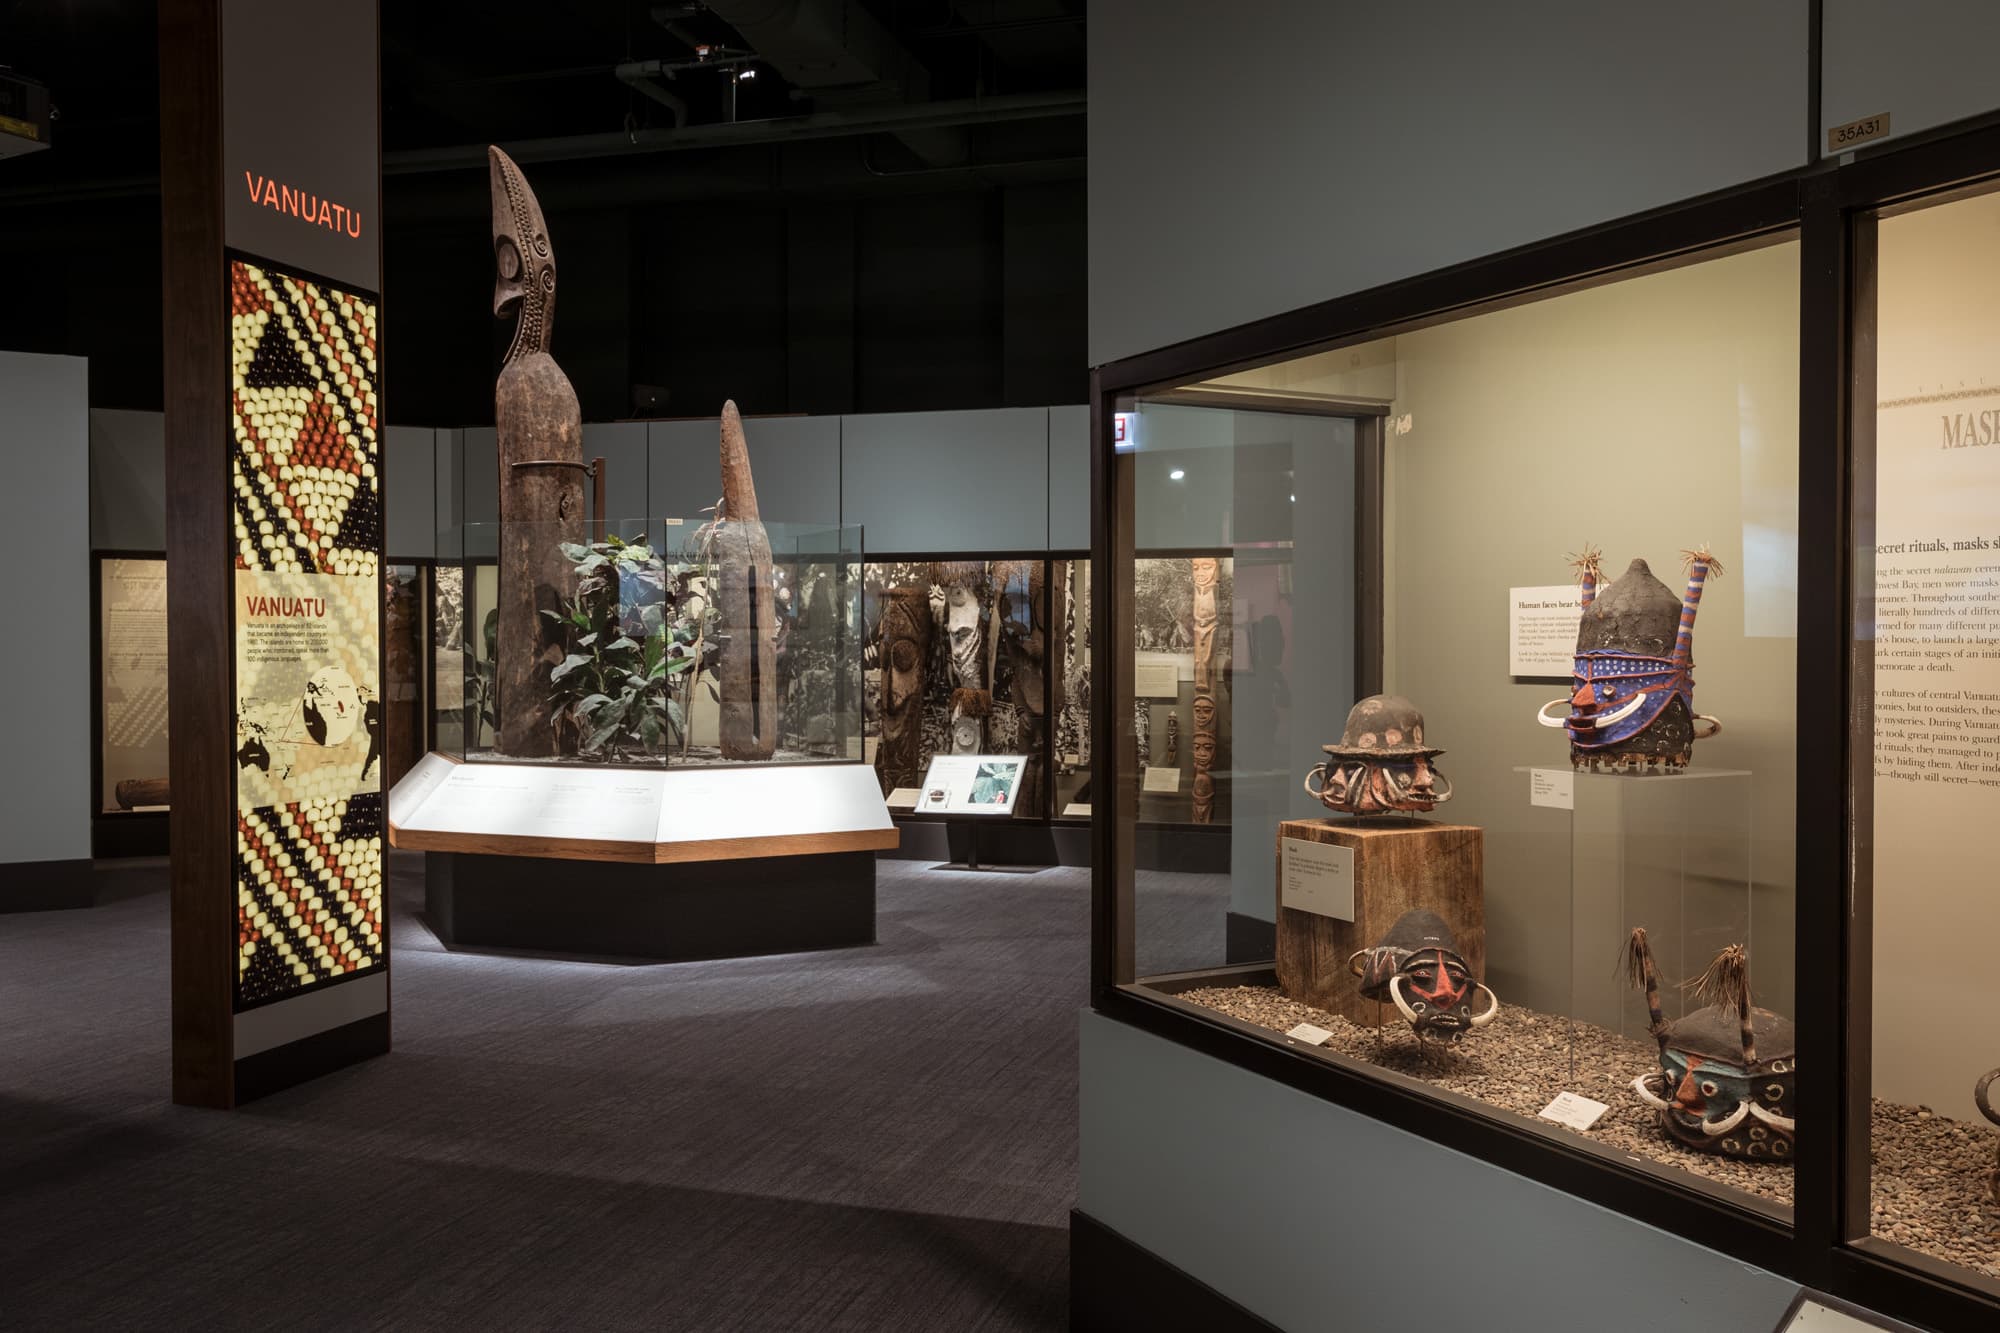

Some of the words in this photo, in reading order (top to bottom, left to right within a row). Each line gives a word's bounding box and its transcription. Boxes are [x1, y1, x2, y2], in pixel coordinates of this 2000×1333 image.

[1838, 120, 1880, 142] 35A31
[245, 171, 361, 239] VANUATU
[1909, 538, 1949, 553] rituals,
[1953, 536, 1989, 551] masks
[1970, 577, 1999, 587] masks
[1518, 601, 1541, 609] Human
[1542, 600, 1557, 609] faces
[1559, 600, 1574, 608] bear
[1912, 593, 1965, 604] Throughout
[246, 596, 325, 617] VANUATU
[1879, 607, 1911, 619] literally
[1913, 607, 1955, 616] hundreds
[1958, 607, 1969, 616] of
[1903, 621, 1915, 630] for
[1919, 622, 1943, 632] many
[1946, 621, 1986, 630] different
[1921, 636, 1931, 644] to
[1933, 635, 1964, 644] launch
[1891, 648, 1921, 657] certain
[1924, 649, 1951, 659] stages
[1954, 649, 1965, 658] of
[1926, 662, 1955, 672] death.
[1881, 688, 1915, 698] cultures
[1917, 689, 1929, 698] of
[1929, 690, 1961, 700] central
[1907, 702, 1921, 712] but
[1924, 704, 1933, 713] to
[1935, 704, 1980, 715] outsiders,
[1884, 716, 1926, 727] mysteries.
[1929, 717, 1961, 730] During
[1886, 729, 1905, 738] took
[1907, 732, 1929, 741] great
[1932, 732, 1957, 742] pains
[1960, 734, 1969, 743] to
[1916, 744, 1935, 756] they
[1937, 747, 1981, 759] managed
[1983, 749, 1993, 758] to
[1884, 755, 1894, 766] by
[1897, 756, 1926, 769] hiding
[1927, 759, 1953, 769] them.
[1955, 760, 1979, 771] After
[1923, 772, 1940, 782] still
